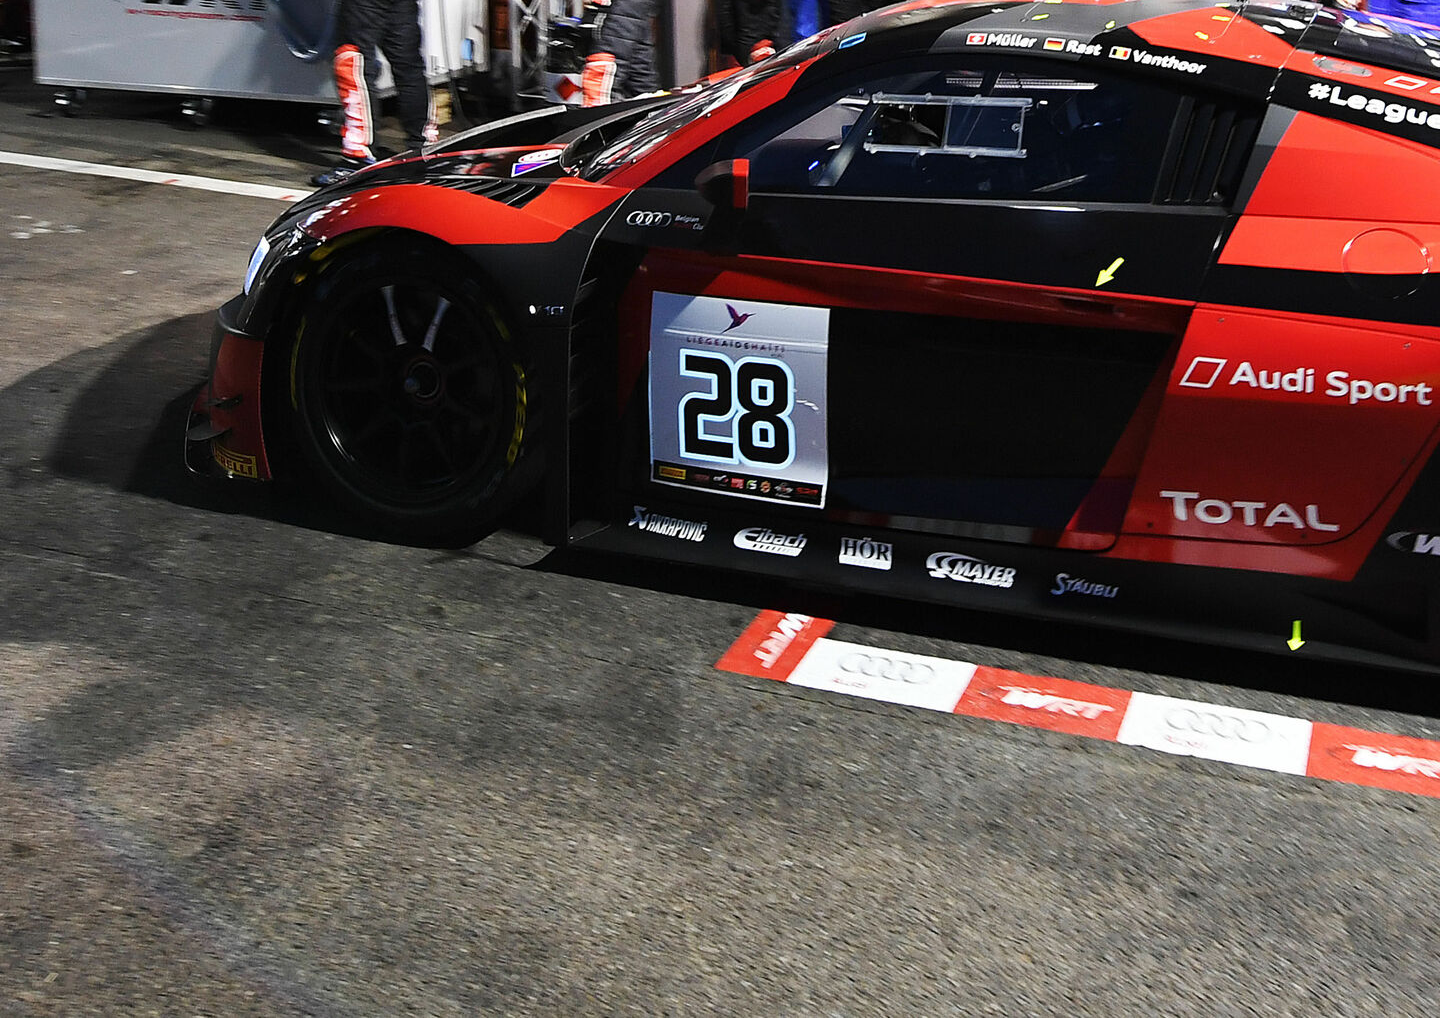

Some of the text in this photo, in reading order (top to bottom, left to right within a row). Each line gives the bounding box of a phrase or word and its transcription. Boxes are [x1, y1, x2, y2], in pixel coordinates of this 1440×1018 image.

[987, 32, 1208, 75] Müller Rast Vanthoor
[674, 214, 700, 223] Belgian
[1229, 361, 1433, 406] Audi Sport
[678, 348, 796, 470] 28
[1159, 490, 1341, 532] TOTAL
[741, 527, 808, 549] Eibach
[842, 537, 890, 562] HÖR
[951, 561, 1018, 584] MAYER
[753, 612, 813, 670] WRT
[1000, 687, 1115, 720] WRT
